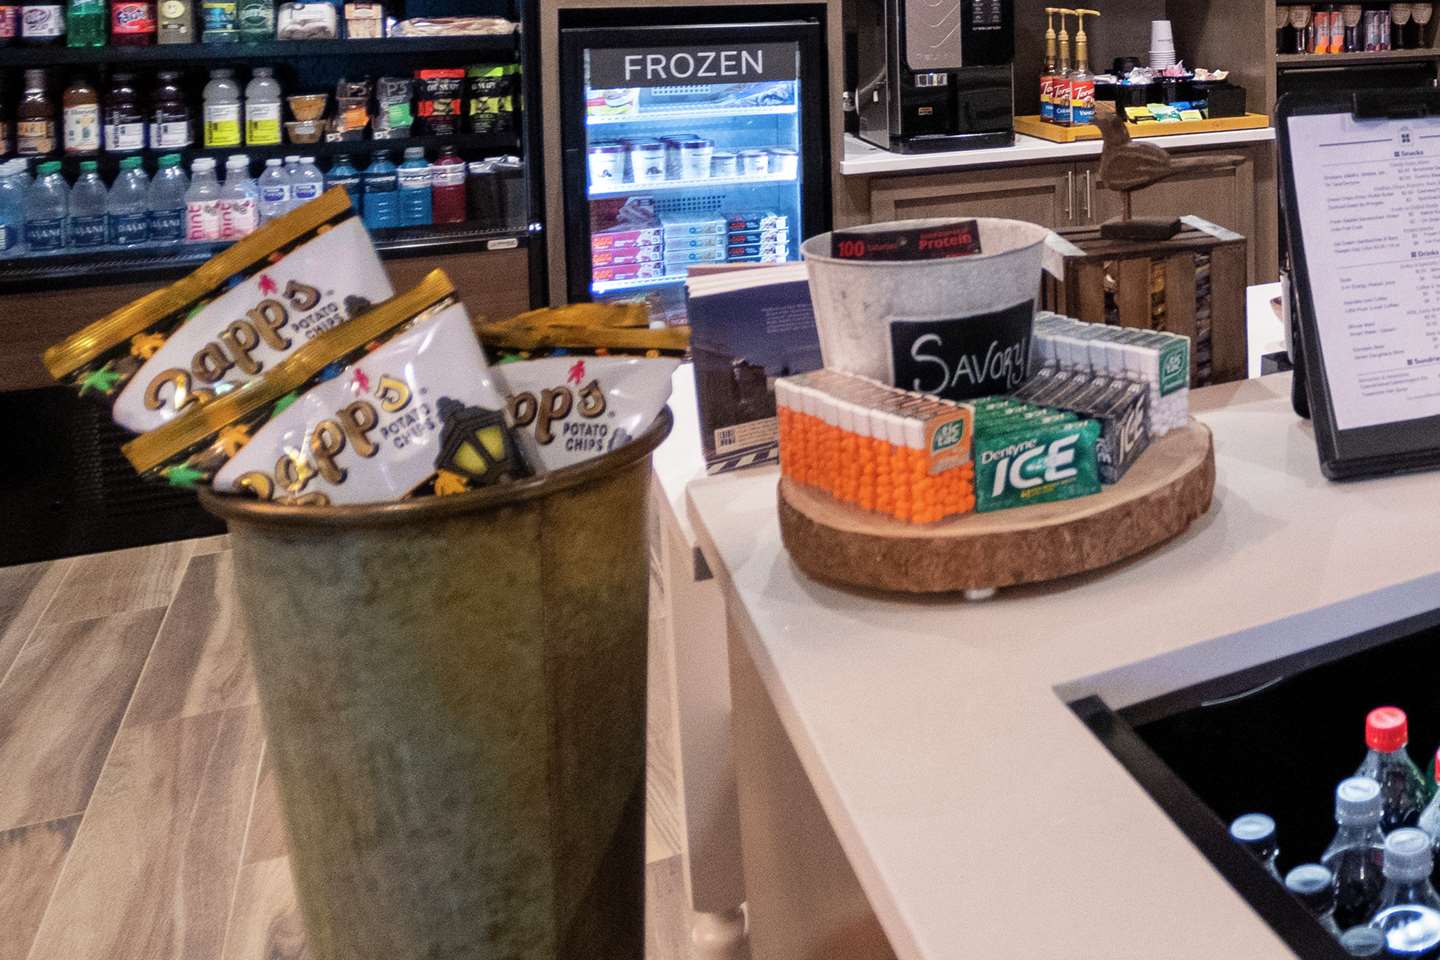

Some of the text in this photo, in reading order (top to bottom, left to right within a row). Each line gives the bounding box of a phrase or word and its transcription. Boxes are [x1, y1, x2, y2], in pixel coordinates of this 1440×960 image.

[624, 50, 764, 81] FROZEN
[189, 204, 204, 239] hint
[221, 204, 234, 238] hint
[838, 240, 865, 257] 100
[918, 233, 972, 250] Protein
[292, 302, 339, 333] POTATO
[379, 403, 431, 440] POTATO
[563, 422, 608, 437] POTATO
[942, 422, 962, 435] tic
[1120, 395, 1145, 464] ICE
[565, 438, 604, 452] CHIPS
[937, 432, 960, 447] tac
[981, 439, 1038, 465] Dentyne
[991, 434, 1080, 498] ICE
